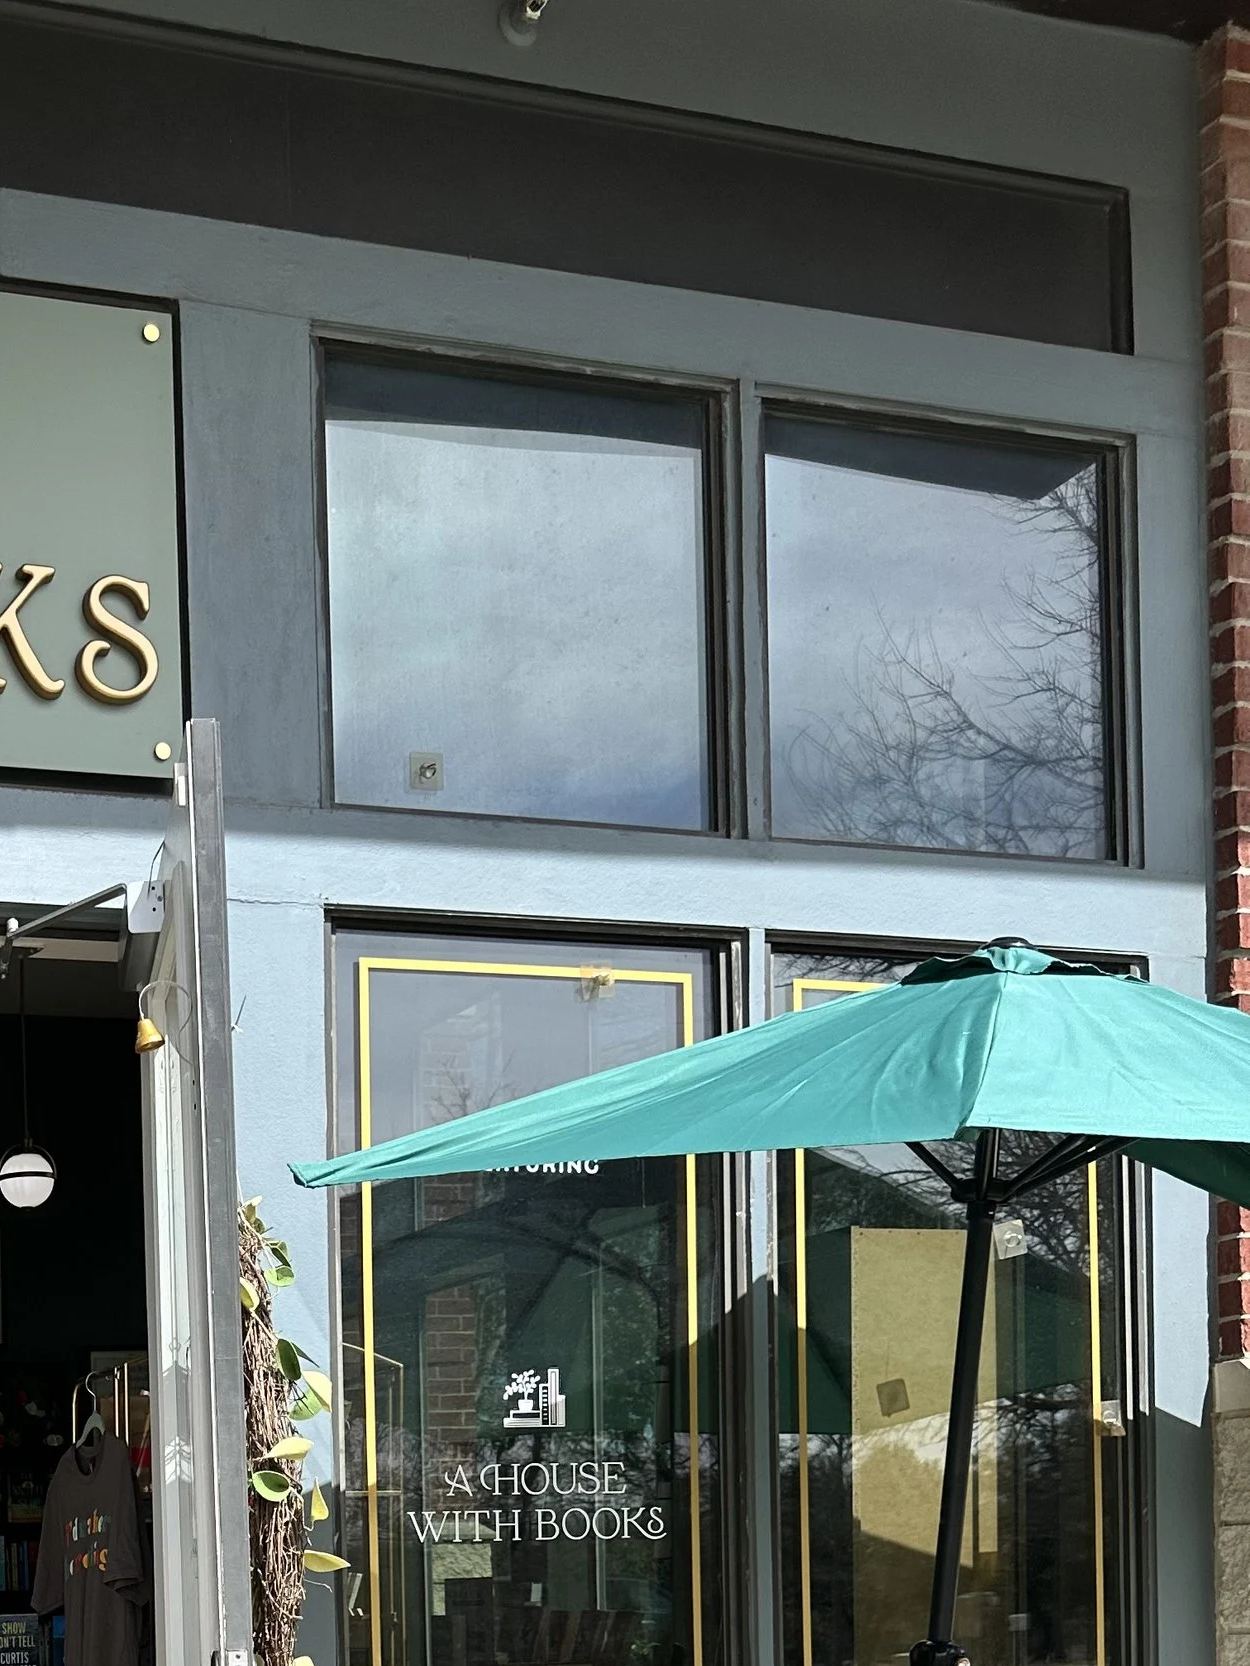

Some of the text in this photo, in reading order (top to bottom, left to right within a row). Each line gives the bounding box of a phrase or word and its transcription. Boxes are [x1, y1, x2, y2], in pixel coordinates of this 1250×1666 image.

[444, 1461, 627, 1497] A HOUSE
[406, 1507, 667, 1543] WITH BOOKS
[2, 1622, 26, 1634] SHOW
[18, 1635, 35, 1648] TELL
[0, 1651, 29, 1665] CURTIS
